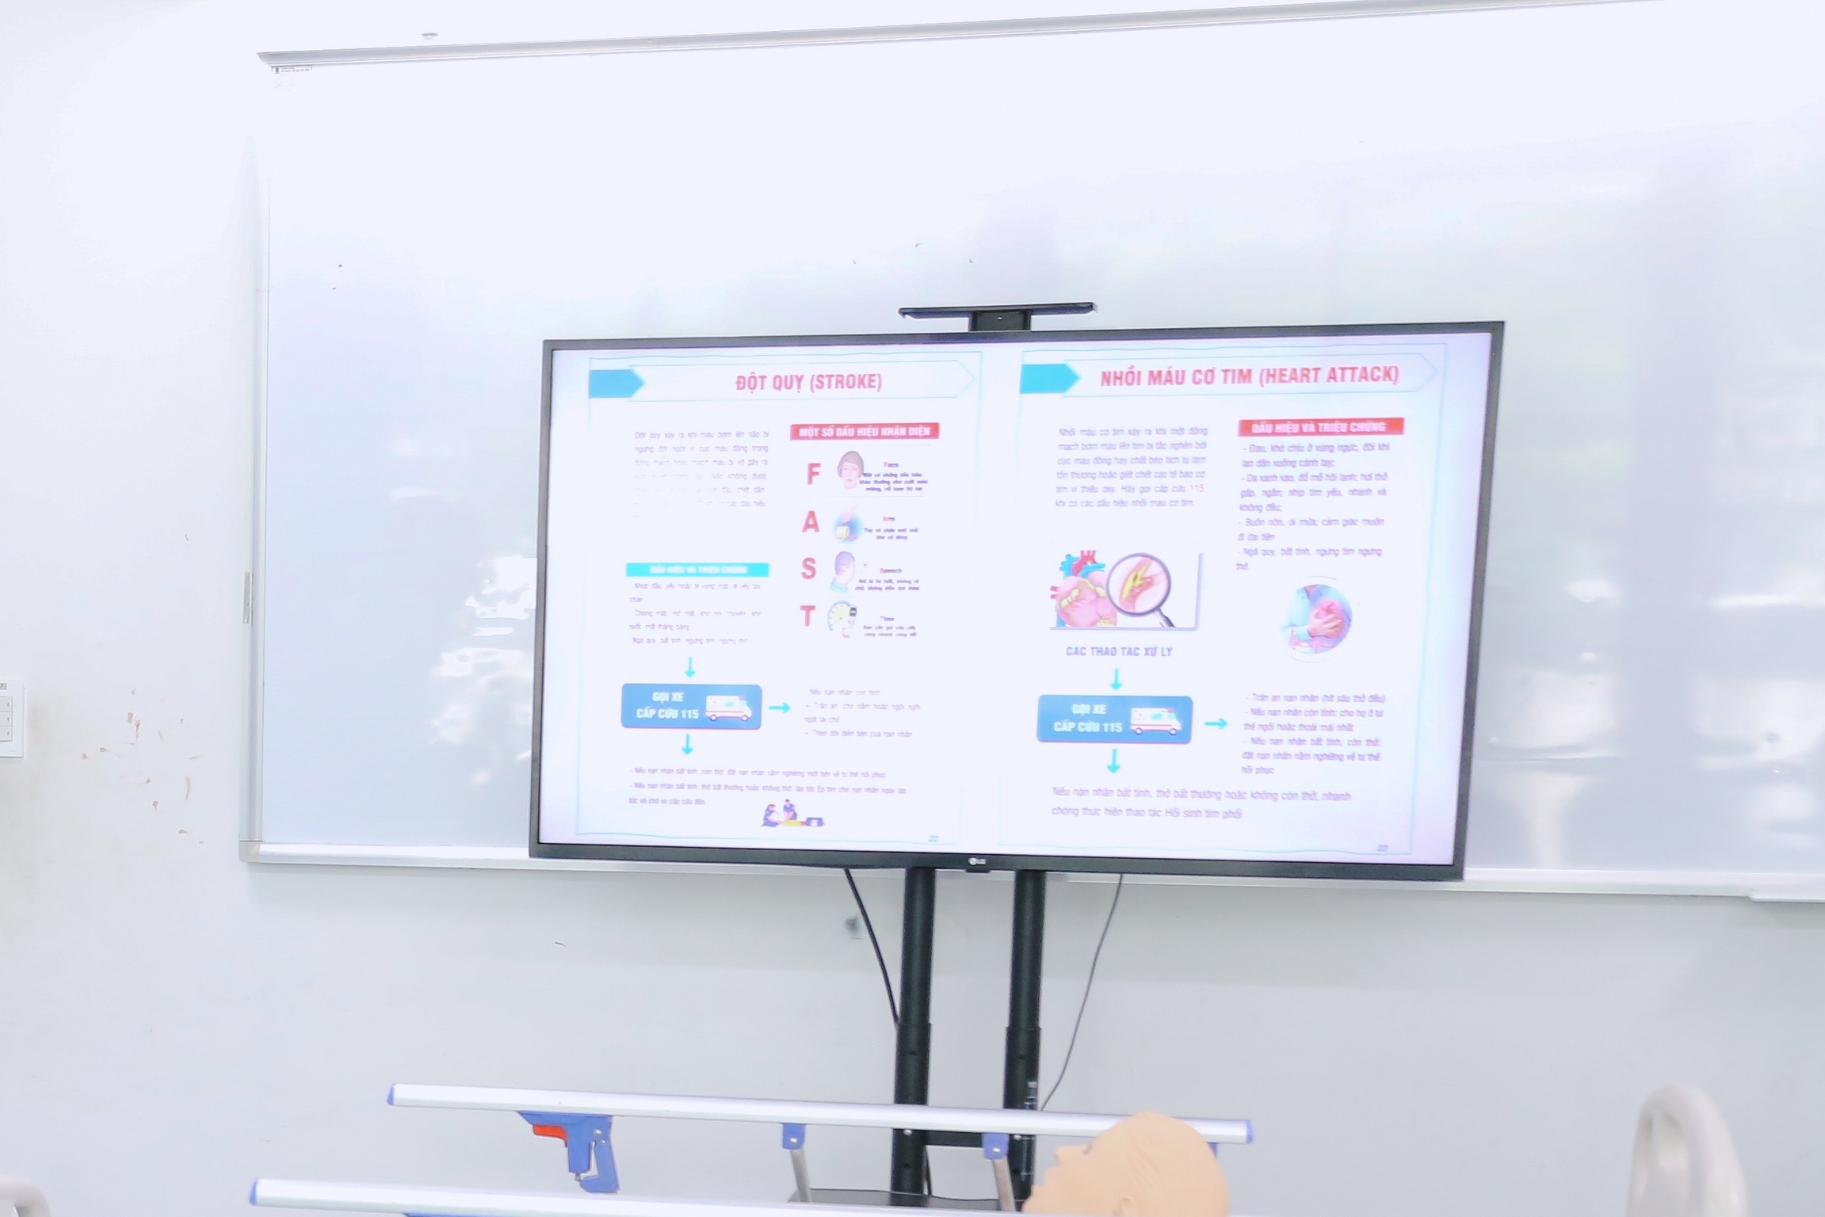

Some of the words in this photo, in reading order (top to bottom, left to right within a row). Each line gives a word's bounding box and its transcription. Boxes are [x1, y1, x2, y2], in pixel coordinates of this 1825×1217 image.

[736, 371, 767, 394] ĐỘT
[772, 374, 805, 394] QUỴ
[810, 373, 882, 393] (STROKE)
[1101, 364, 1142, 386] NHỒI
[1147, 366, 1186, 386] MÁU
[1192, 367, 1217, 385] CƠ
[1221, 368, 1253, 384] TIM
[1259, 367, 1321, 388] (HEART
[1326, 366, 1399, 385] ATTACK)
[807, 463, 821, 485] F
[802, 510, 820, 532] A
[801, 557, 816, 579] S
[800, 605, 816, 627] T
[671, 692, 684, 702] XE
[680, 709, 699, 719] 115
[1092, 704, 1107, 715] XE
[1102, 722, 1123, 733] 115
